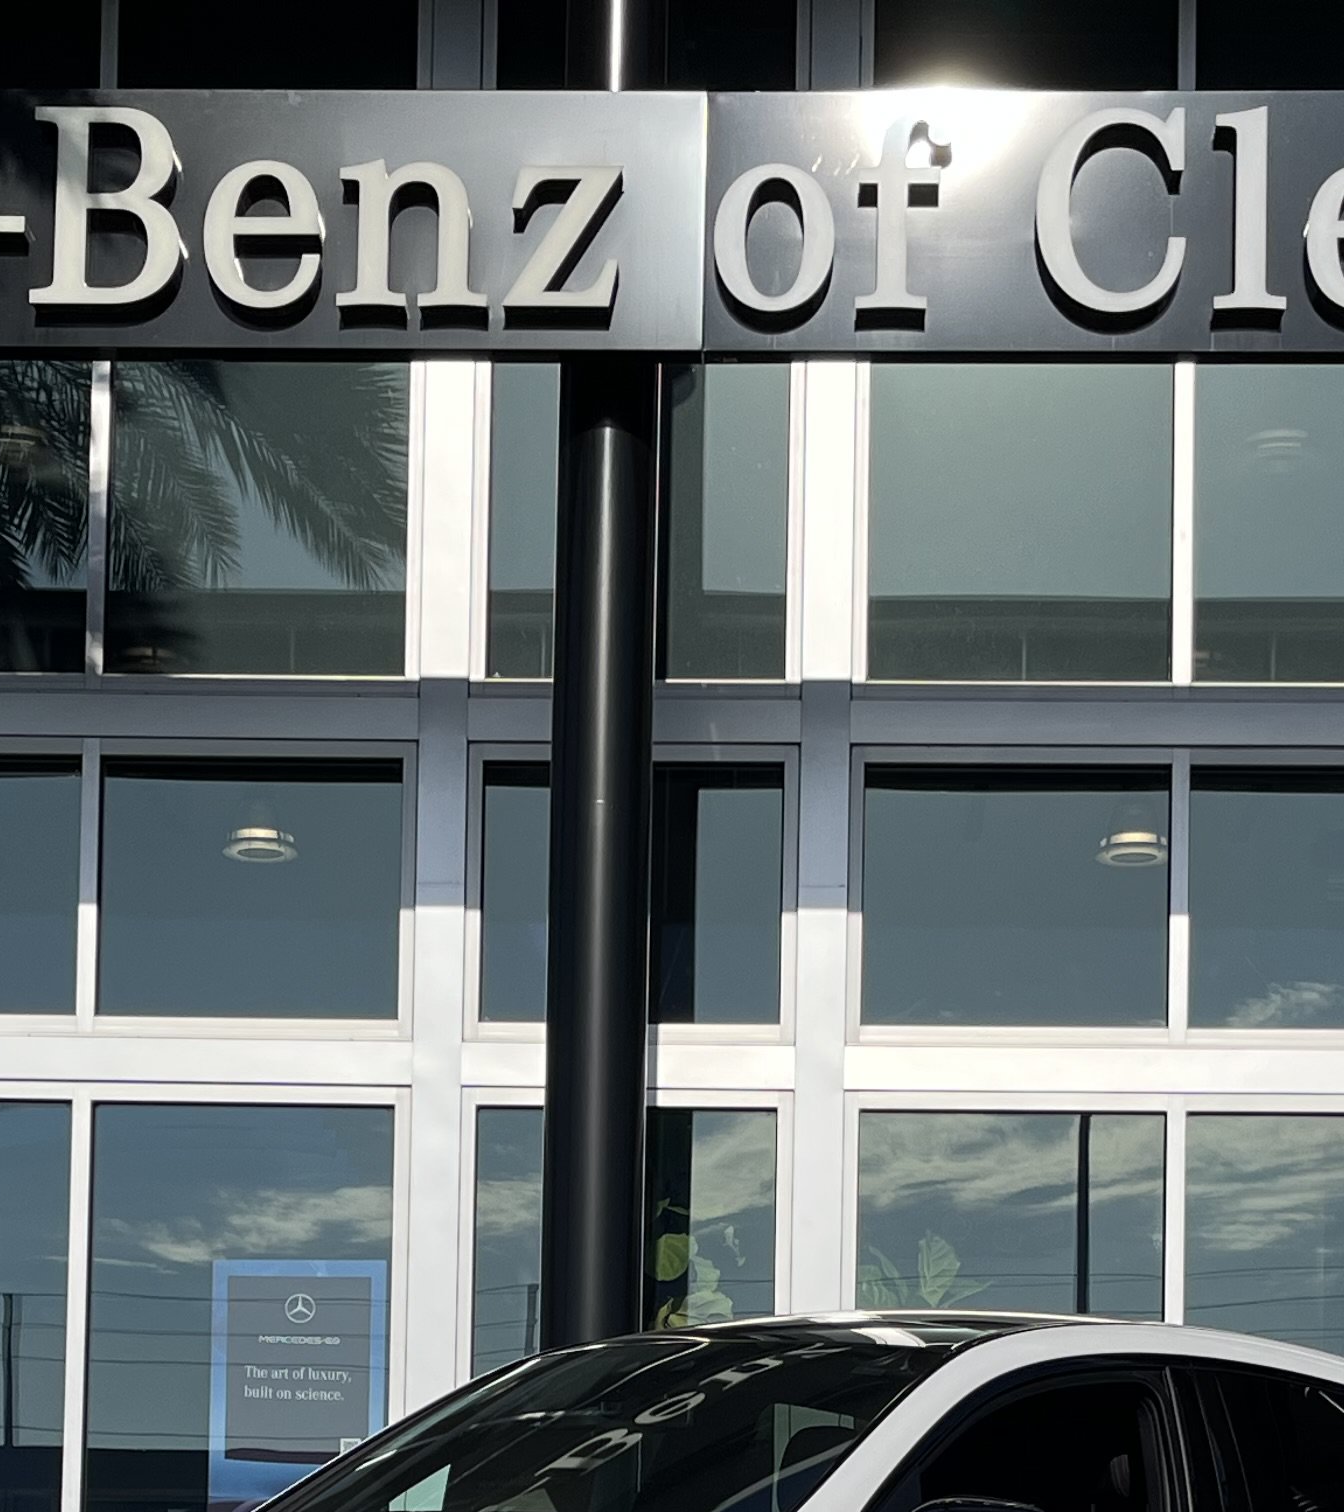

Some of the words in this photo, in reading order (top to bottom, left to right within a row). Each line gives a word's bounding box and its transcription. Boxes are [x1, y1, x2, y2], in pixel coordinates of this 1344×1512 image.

[713, 112, 951, 313] of
[244, 1365, 268, 1379] The
[271, 1368, 289, 1380] art
[292, 1367, 306, 1380] of
[308, 1367, 352, 1384] luxury,
[244, 1385, 272, 1399] built
[276, 1389, 292, 1400] on
[295, 1388, 344, 1401] science.
